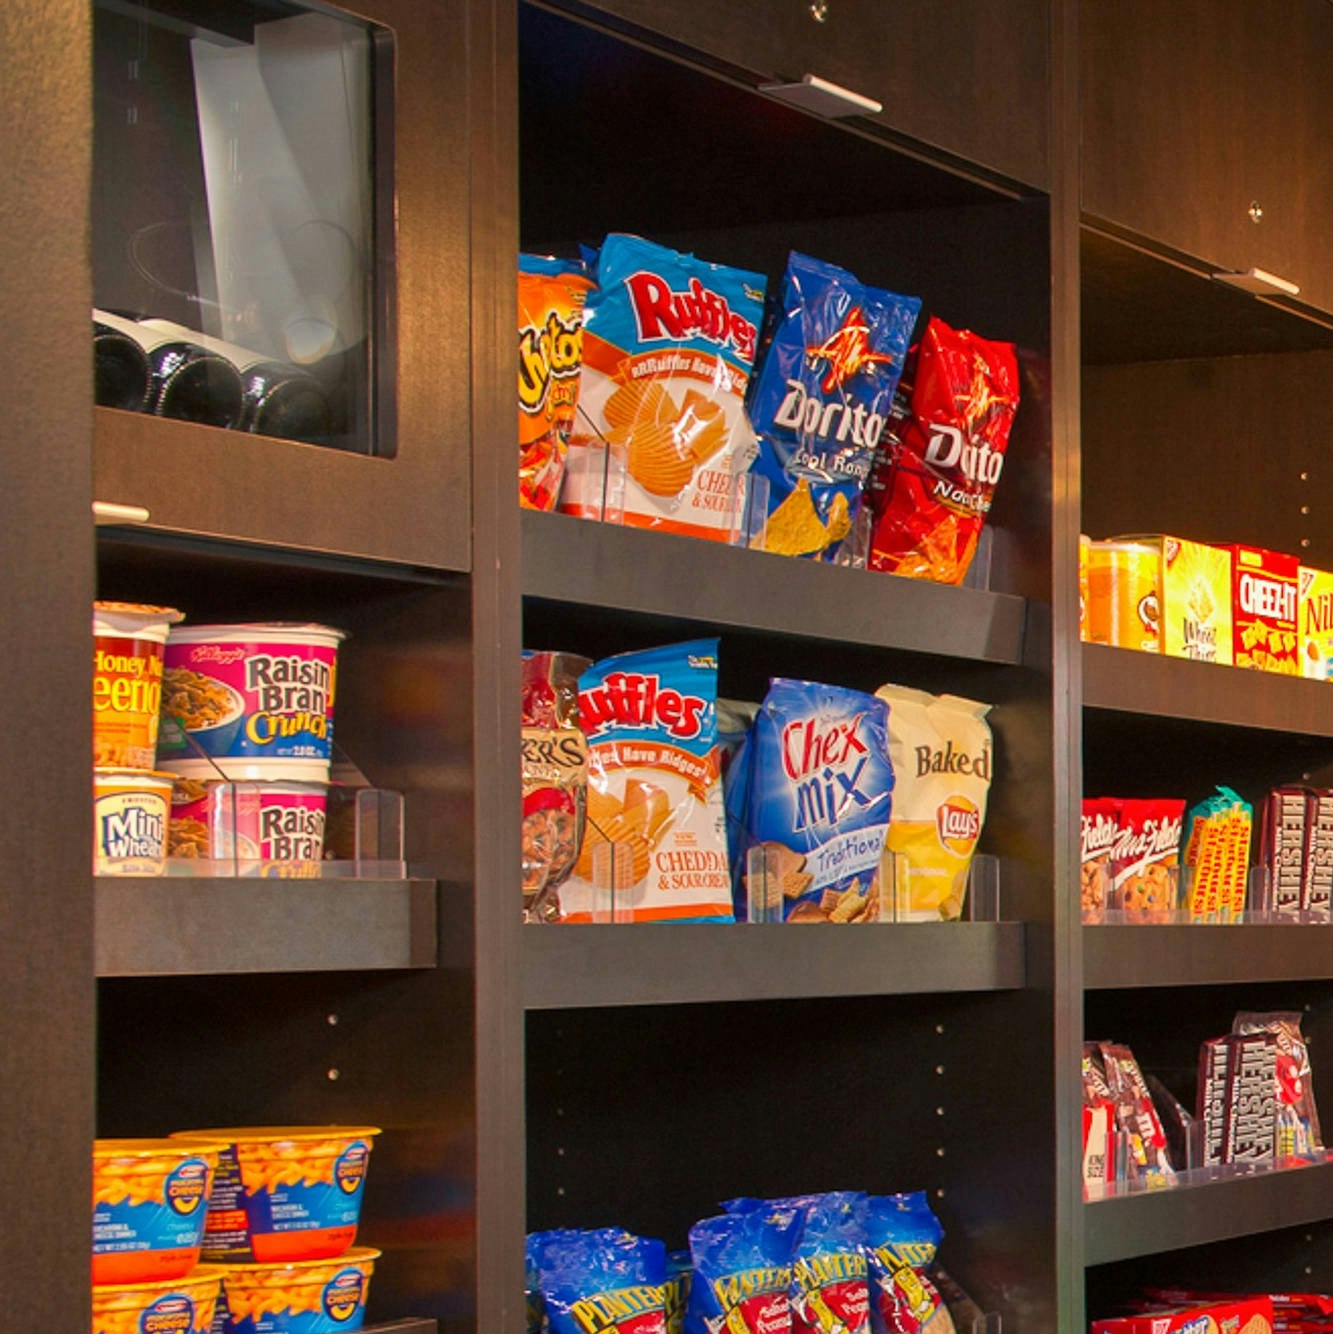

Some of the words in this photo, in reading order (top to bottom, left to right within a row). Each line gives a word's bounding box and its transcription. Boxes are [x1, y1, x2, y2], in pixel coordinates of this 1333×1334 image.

[624, 271, 757, 364] Ruffles
[775, 379, 886, 448] Dorito
[245, 655, 331, 692] Raisin
[258, 684, 327, 715] Bran
[578, 671, 705, 740] uffles
[623, 747, 656, 764] Have
[783, 712, 869, 780] Chex
[915, 740, 990, 782] Baked
[656, 850, 729, 873] CHEDDA
